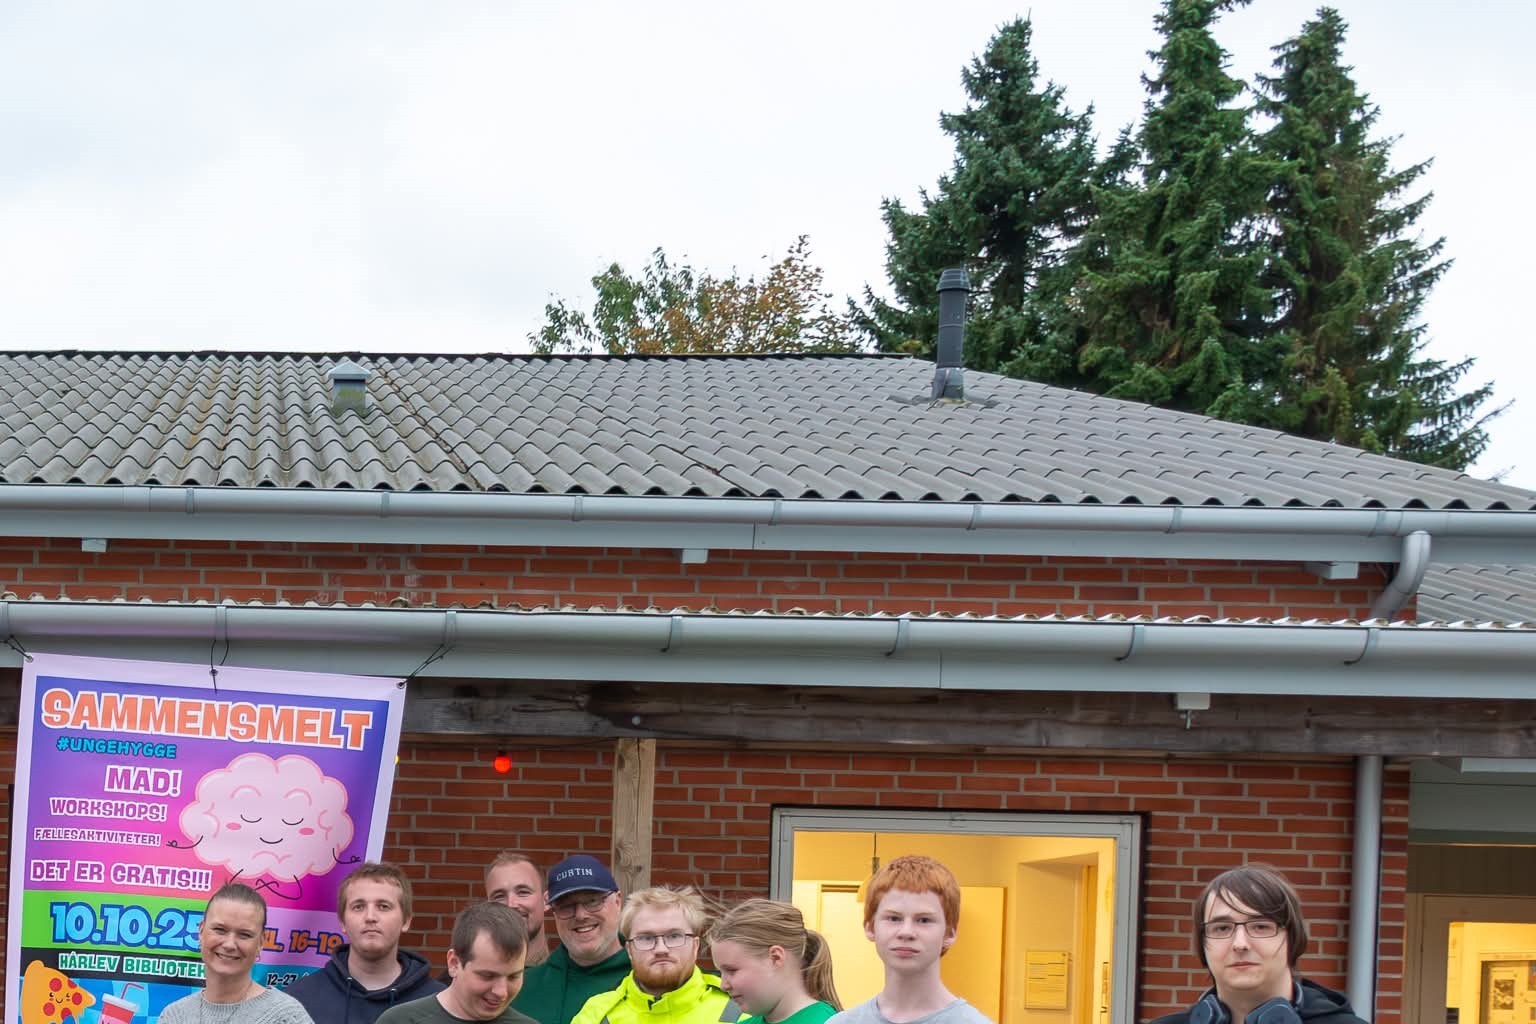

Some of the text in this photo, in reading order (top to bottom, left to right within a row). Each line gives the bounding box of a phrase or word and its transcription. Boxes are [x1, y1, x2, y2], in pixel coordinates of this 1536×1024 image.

[41, 687, 374, 751] SAMMENSMELT
[56, 736, 177, 759] #UNGEHYGGE
[104, 765, 182, 797] MAD!
[49, 797, 168, 822] WORKSHOPS!
[34, 828, 161, 846] FÆLLESAKTIVITETER!
[30, 860, 212, 890] DET ER GRATIS!!!
[556, 867, 593, 881] CURTIN
[50, 902, 204, 952] 10.10.25
[289, 929, 344, 956] 16-19
[58, 951, 206, 980] HÅRLEV BIBLIOTEK
[266, 972, 298, 987] 12-27
